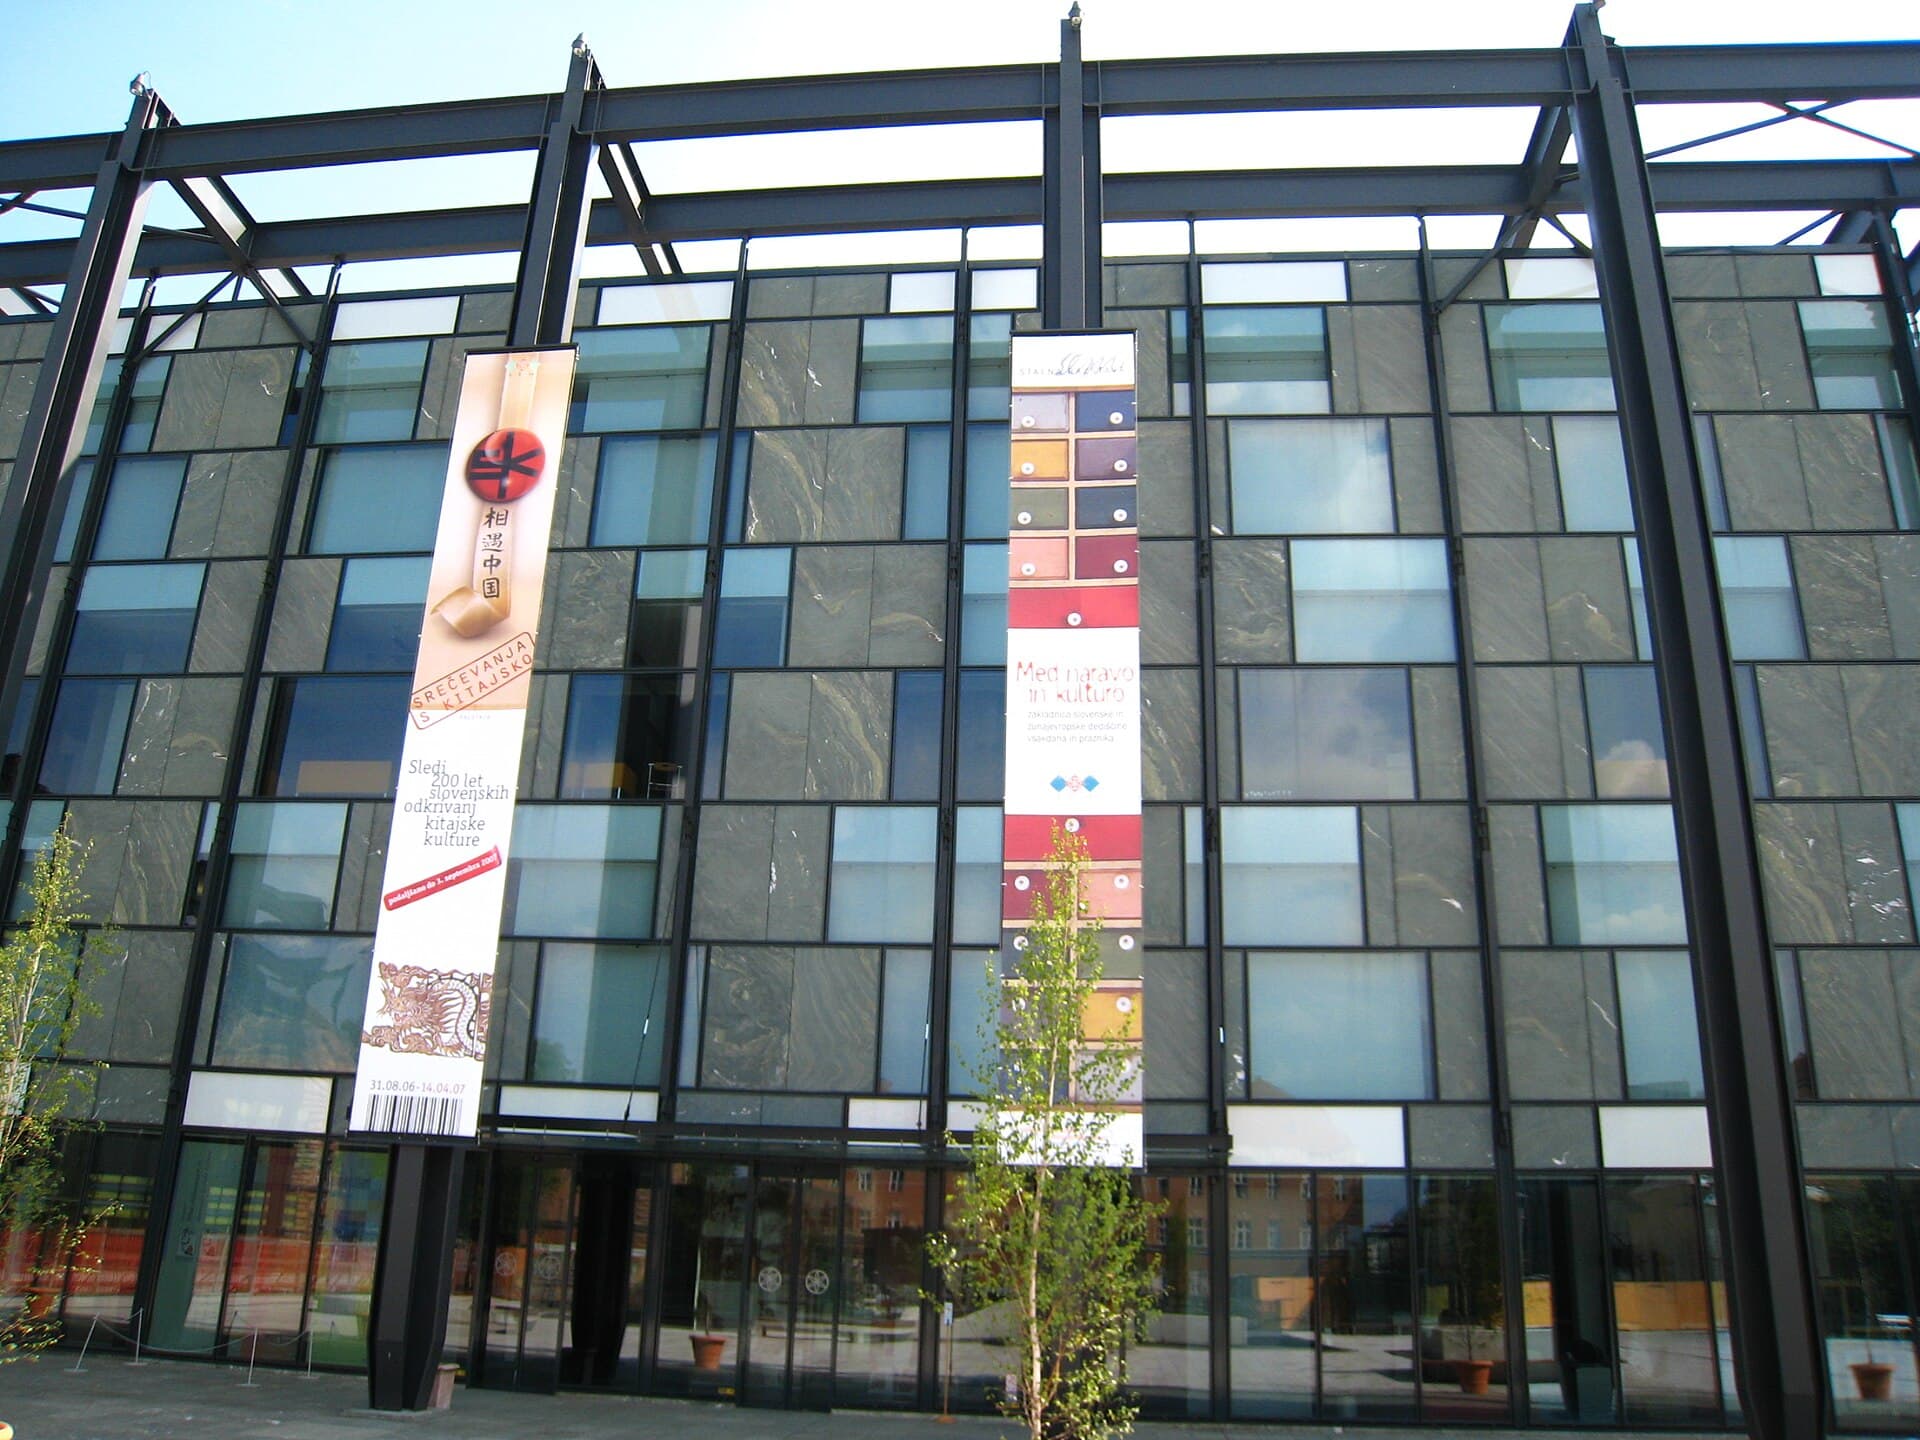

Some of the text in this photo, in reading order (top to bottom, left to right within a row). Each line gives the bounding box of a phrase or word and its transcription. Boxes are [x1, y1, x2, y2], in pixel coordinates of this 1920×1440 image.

[482, 507, 508, 599] 相遇中国
[413, 640, 527, 708] SREČEVANJA
[1016, 660, 1135, 683] Med naravo
[420, 653, 533, 722] S KITAJSKO
[1029, 683, 1125, 703] in kulturo
[408, 759, 447, 775] Sledi
[431, 773, 483, 788] 200 let
[429, 785, 510, 801] slovenskih
[404, 798, 477, 817] odkrivanj
[424, 816, 486, 834] kitajske
[424, 831, 480, 847] kulture
